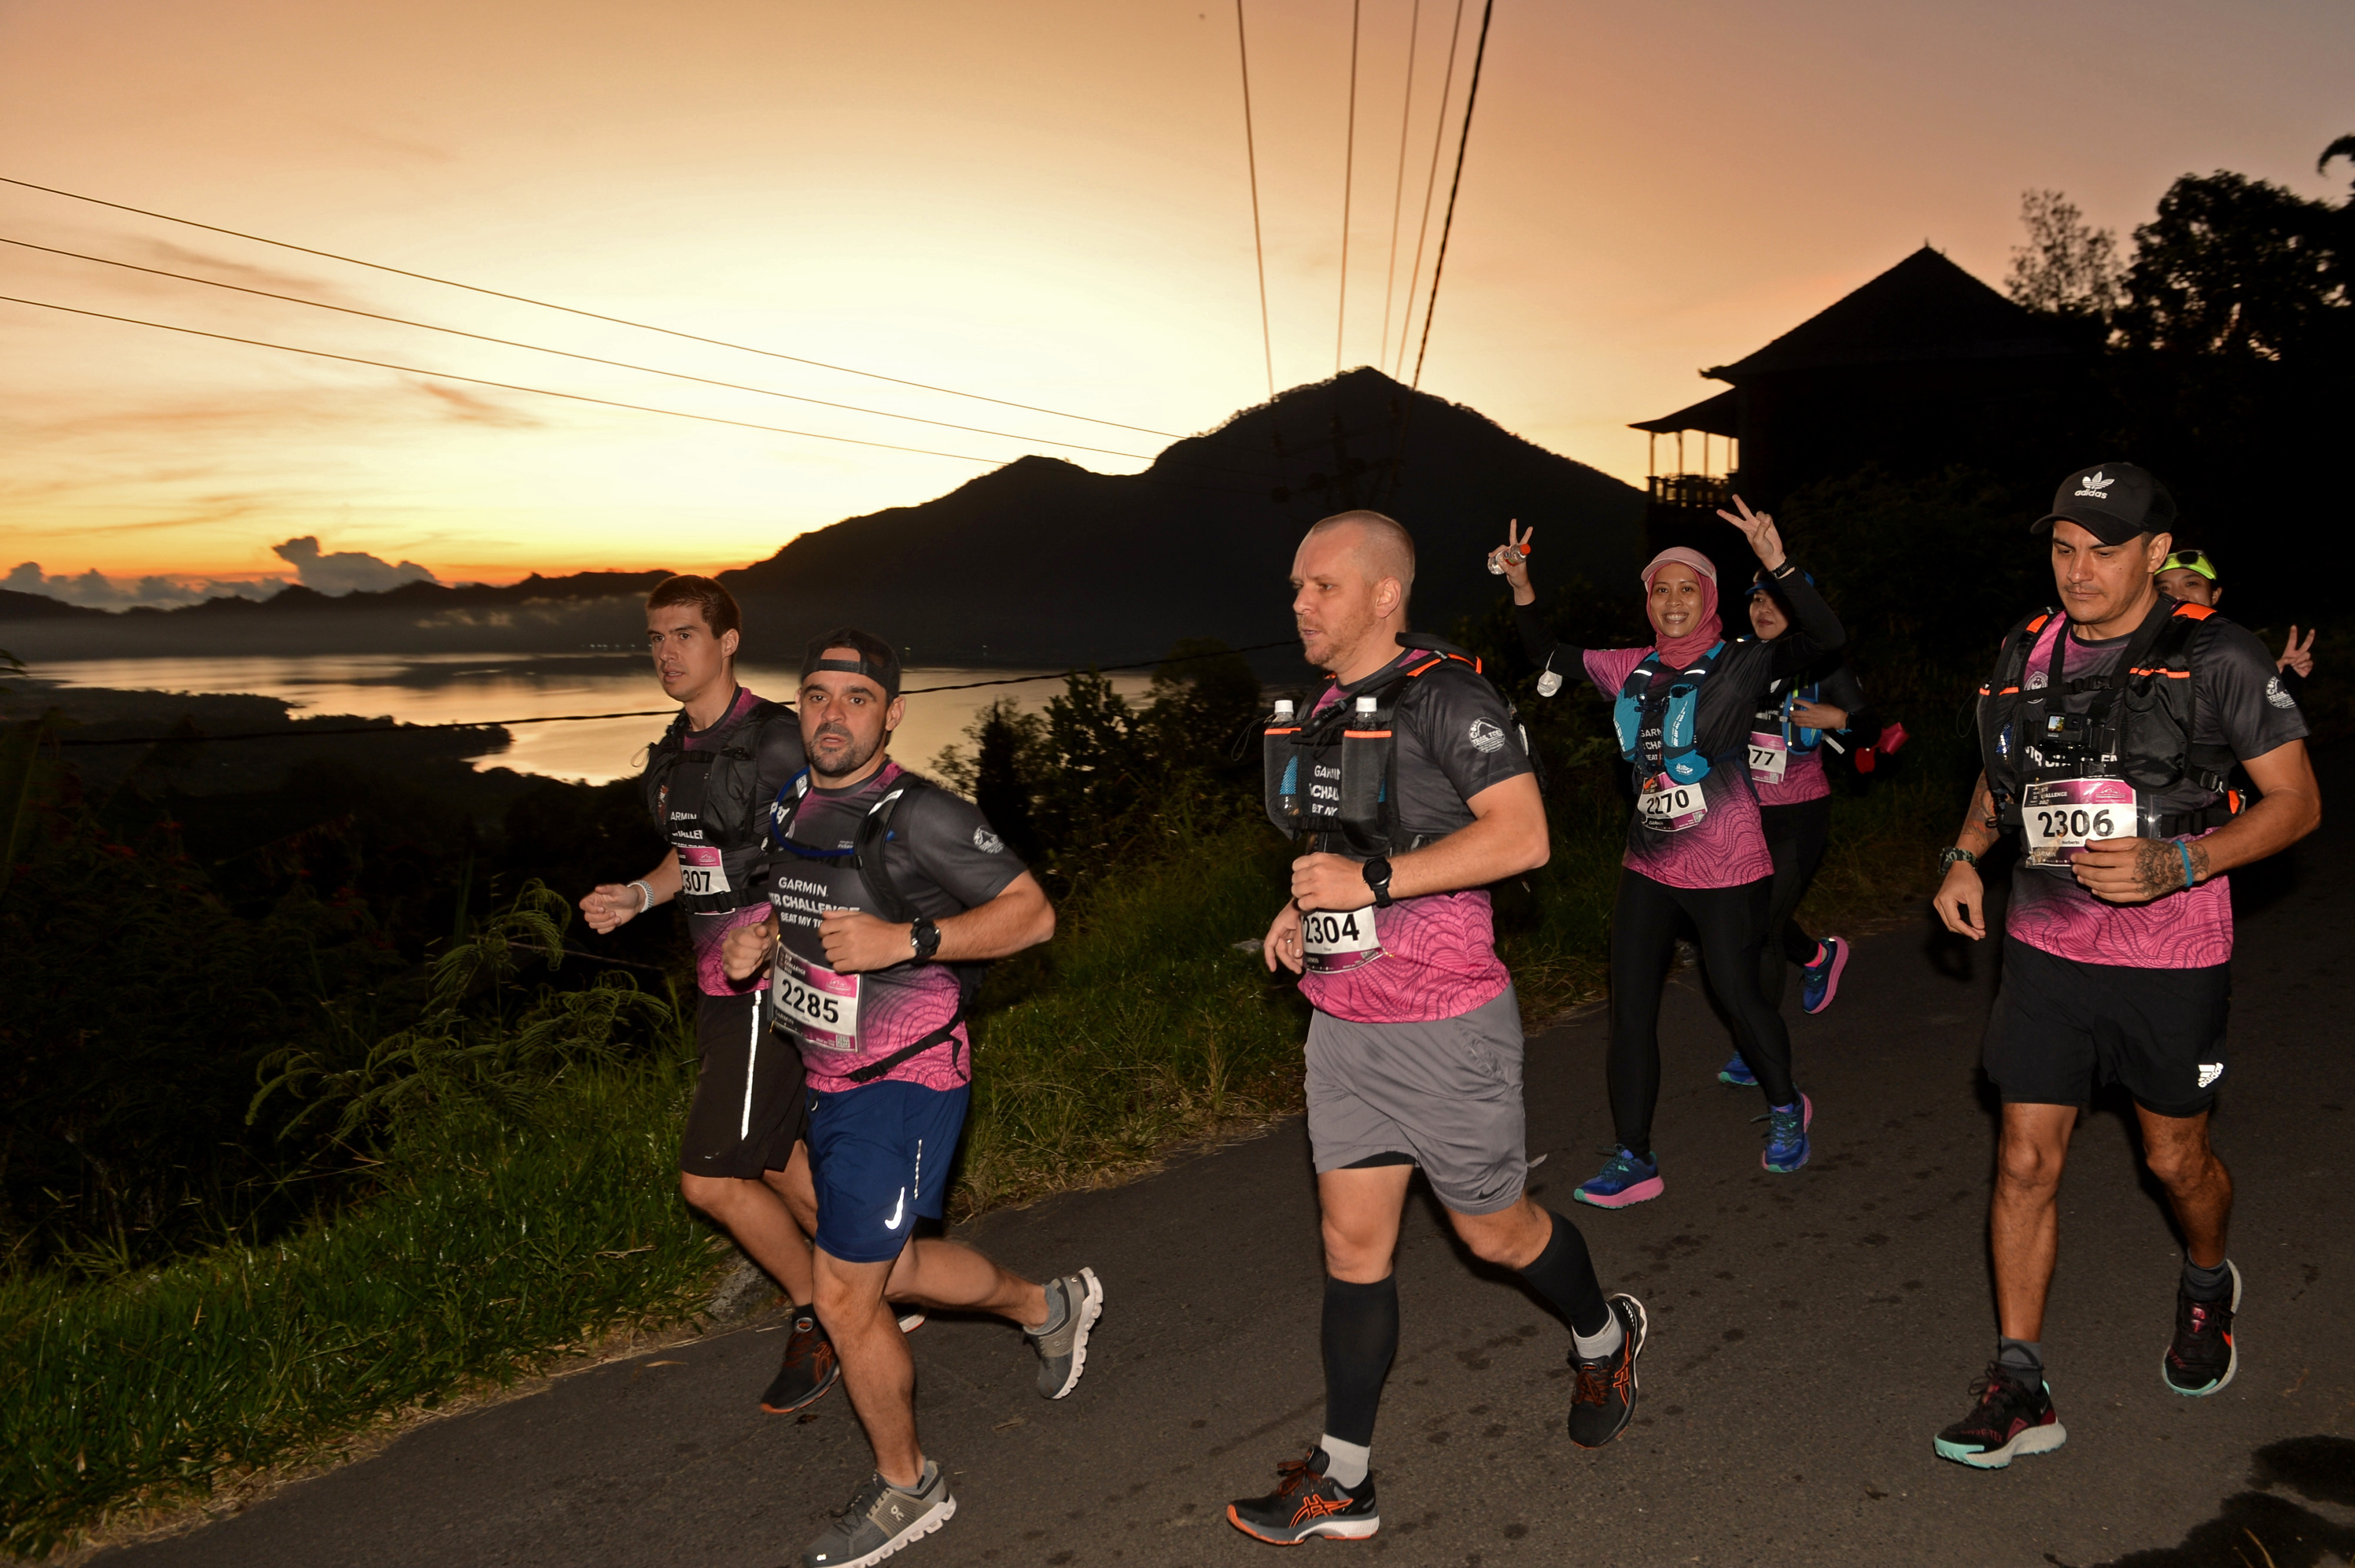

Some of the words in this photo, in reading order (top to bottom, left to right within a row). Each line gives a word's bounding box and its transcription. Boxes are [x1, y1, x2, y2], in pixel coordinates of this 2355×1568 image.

[2074, 488, 2108, 499] adidas
[1752, 748, 1776, 765] 77
[1646, 789, 1690, 815] 2270
[2038, 809, 2114, 838] 2306
[682, 869, 711, 893] 307
[778, 877, 828, 898] GARMIN
[781, 911, 797, 924] BEAT
[798, 915, 812, 927] MY
[1303, 913, 1360, 944] 2304
[782, 978, 839, 1023] 2285
